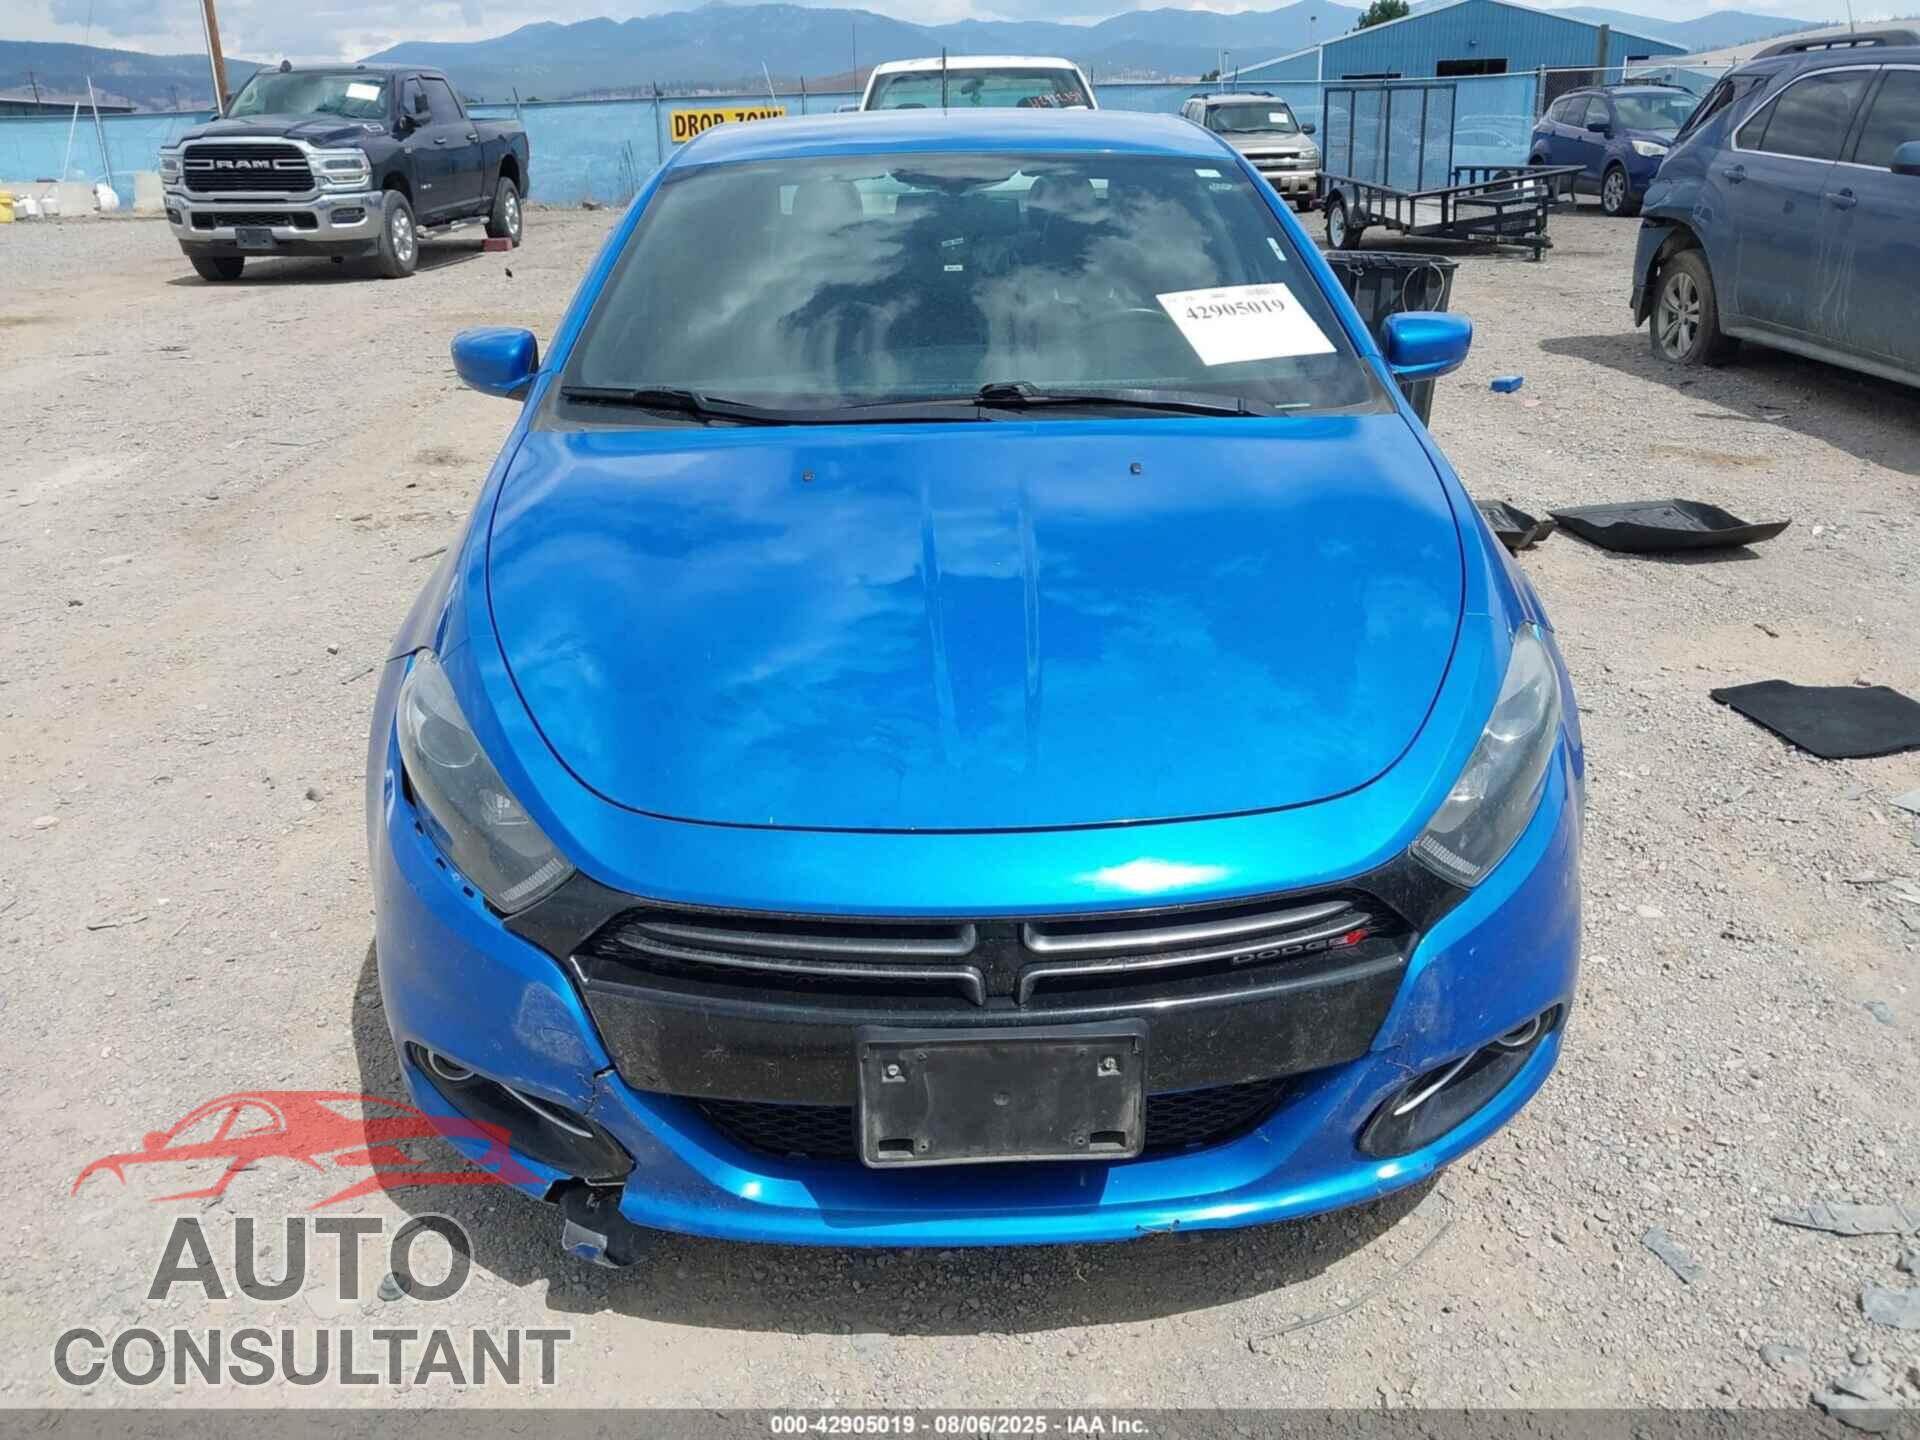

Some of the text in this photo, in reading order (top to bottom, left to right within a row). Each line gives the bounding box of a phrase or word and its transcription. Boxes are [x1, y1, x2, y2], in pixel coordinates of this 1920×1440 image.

[216, 159, 270, 169] RAM
[1186, 299, 1286, 320] 42905019
[1232, 937, 1348, 964] DODGE
